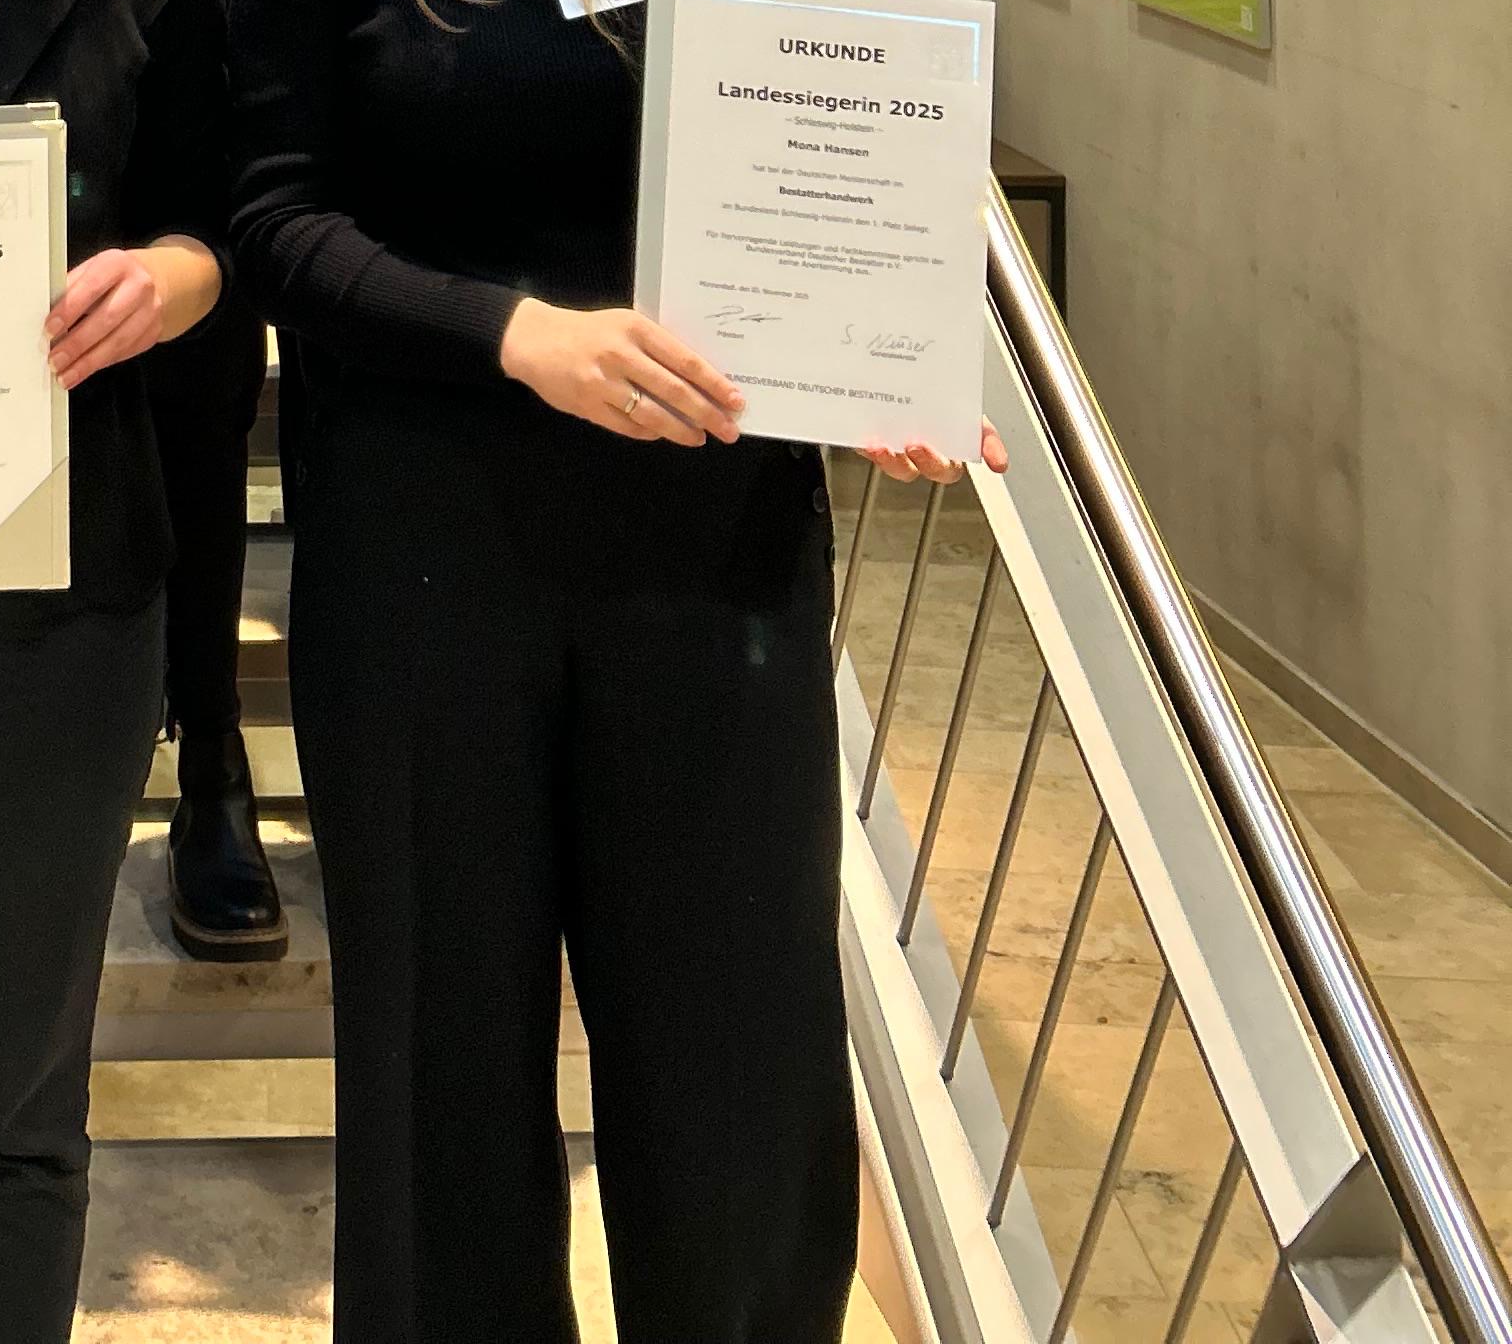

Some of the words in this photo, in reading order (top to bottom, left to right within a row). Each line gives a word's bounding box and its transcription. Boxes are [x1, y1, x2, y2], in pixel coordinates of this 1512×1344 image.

[779, 38, 885, 63] URKUNDE
[718, 81, 880, 113] Landessiegerin
[889, 99, 943, 120] 2025
[787, 139, 820, 151] Mona
[824, 143, 869, 156] Hansen
[778, 185, 873, 204] Bestatterhandwerk
